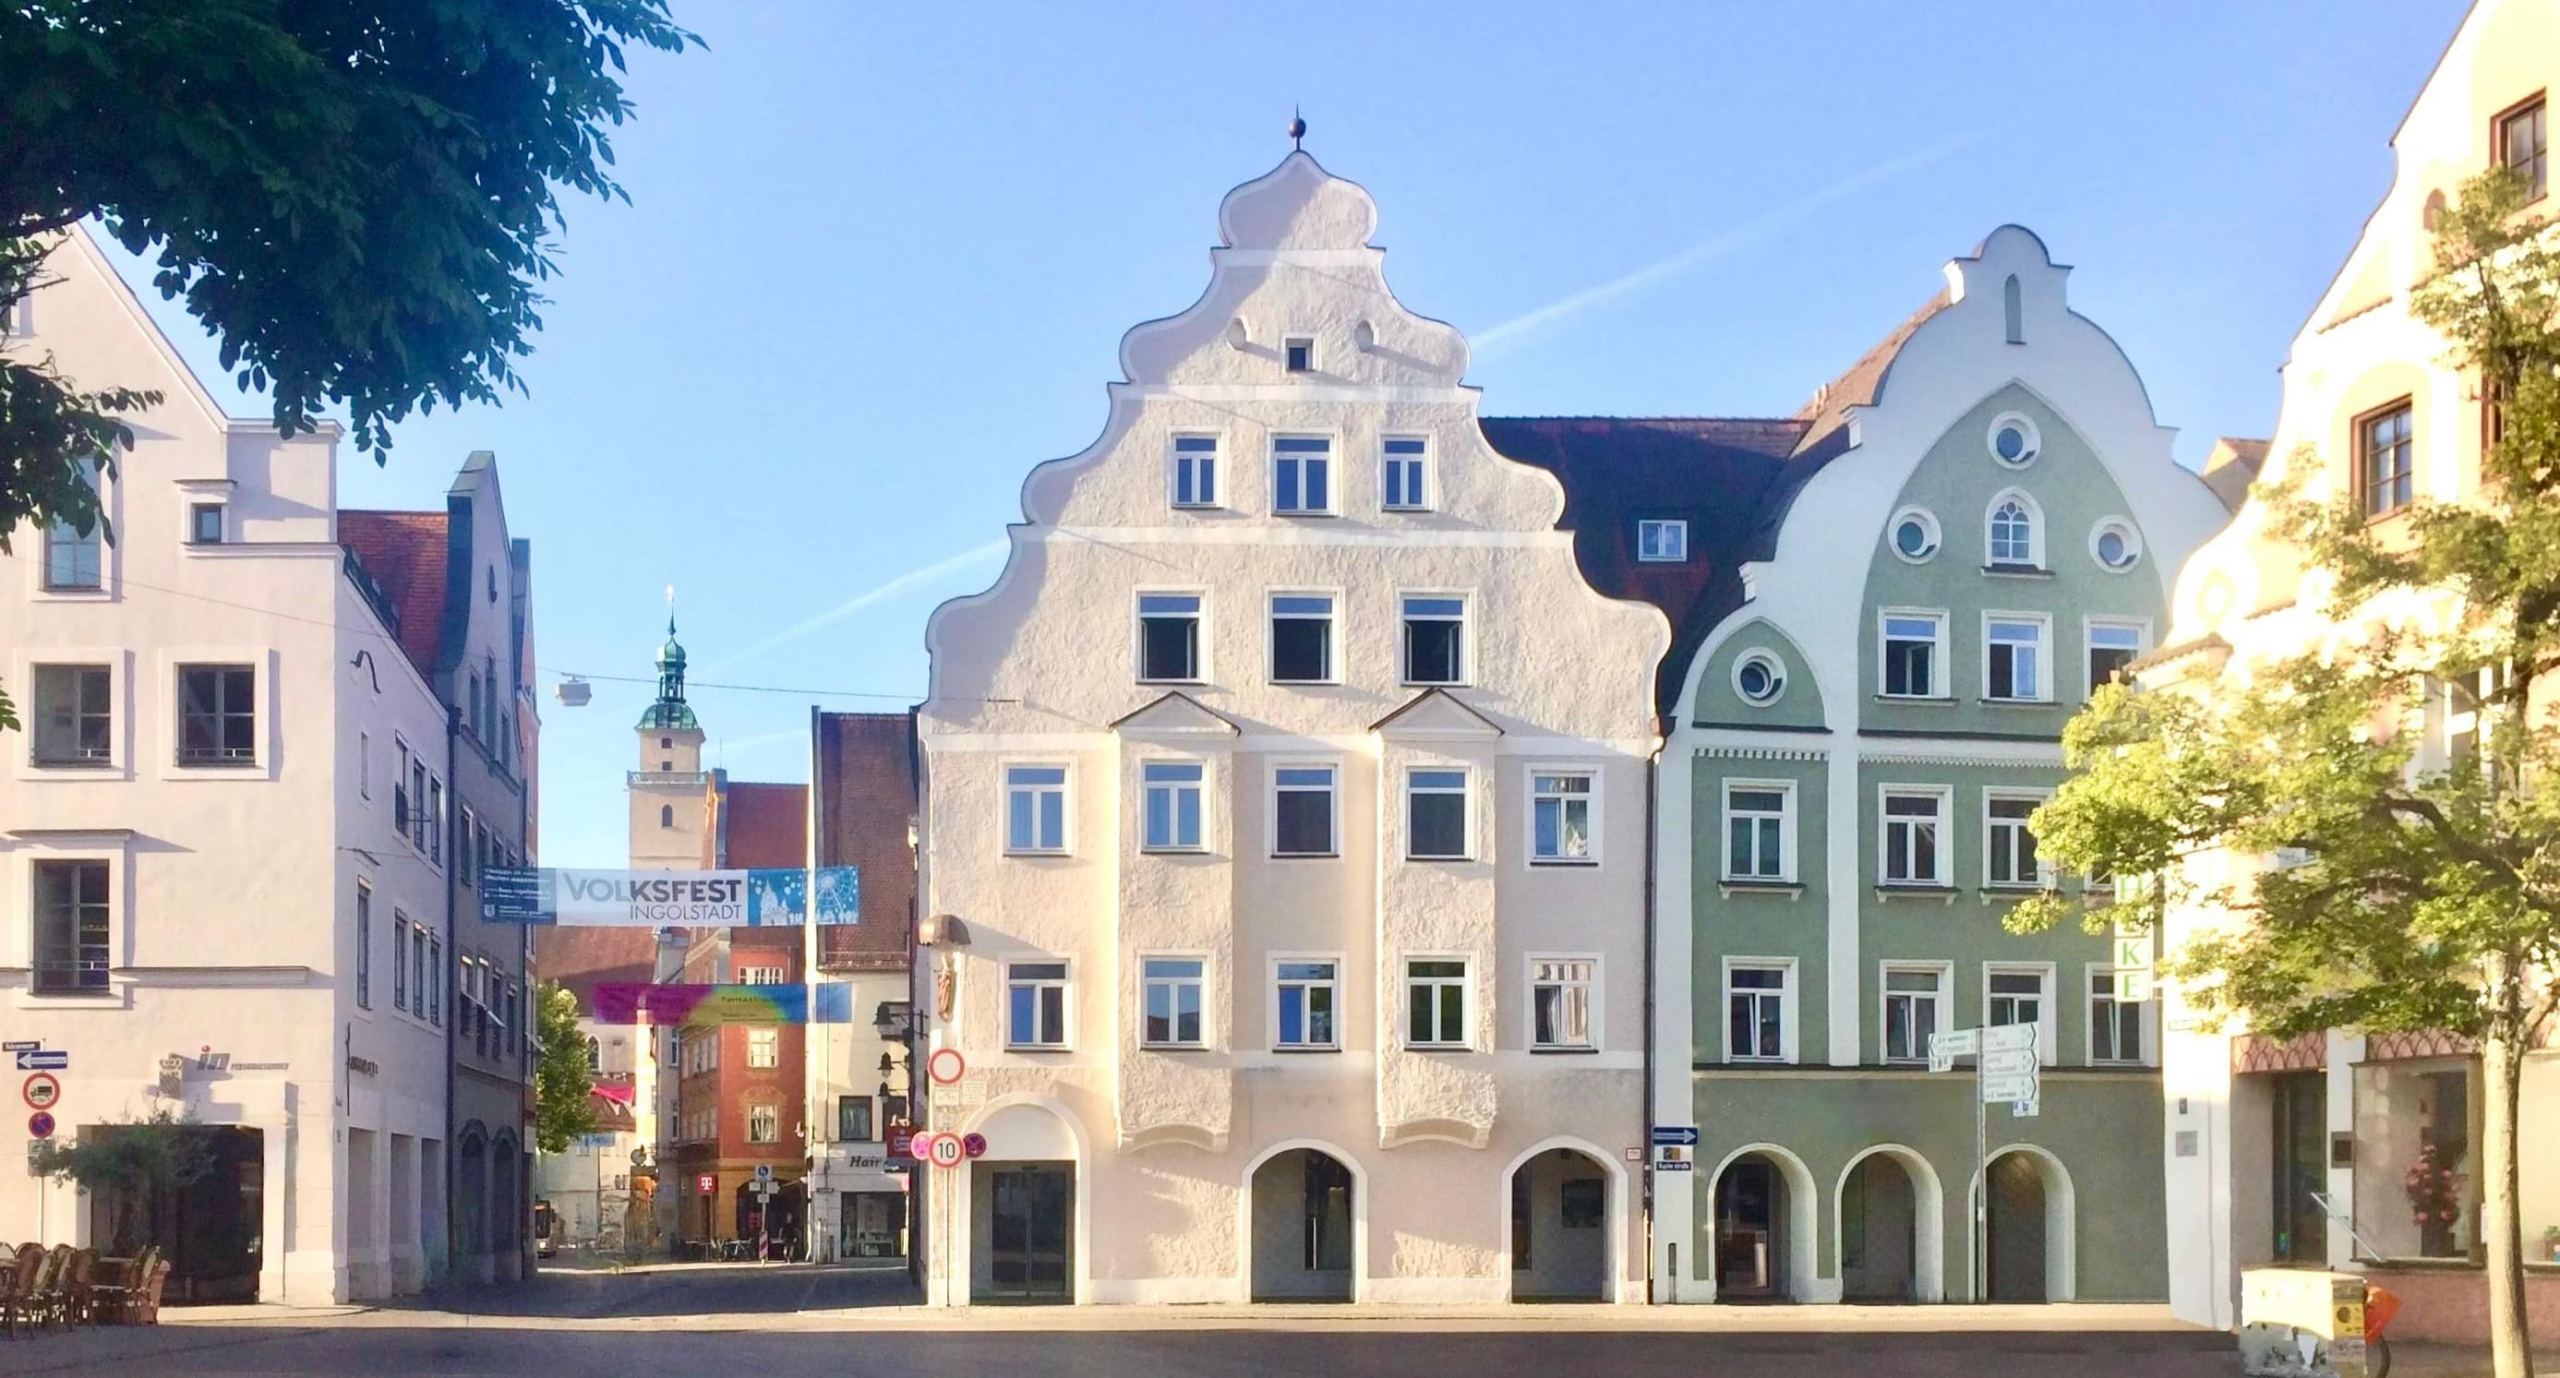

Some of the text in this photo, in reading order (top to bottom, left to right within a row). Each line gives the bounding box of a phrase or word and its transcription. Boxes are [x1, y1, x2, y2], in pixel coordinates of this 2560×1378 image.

[563, 873, 742, 903] VOLKSFEST
[630, 904, 742, 920] INGOLSTADT
[938, 1142, 956, 1159] 10
[849, 1155, 881, 1168] Hair
